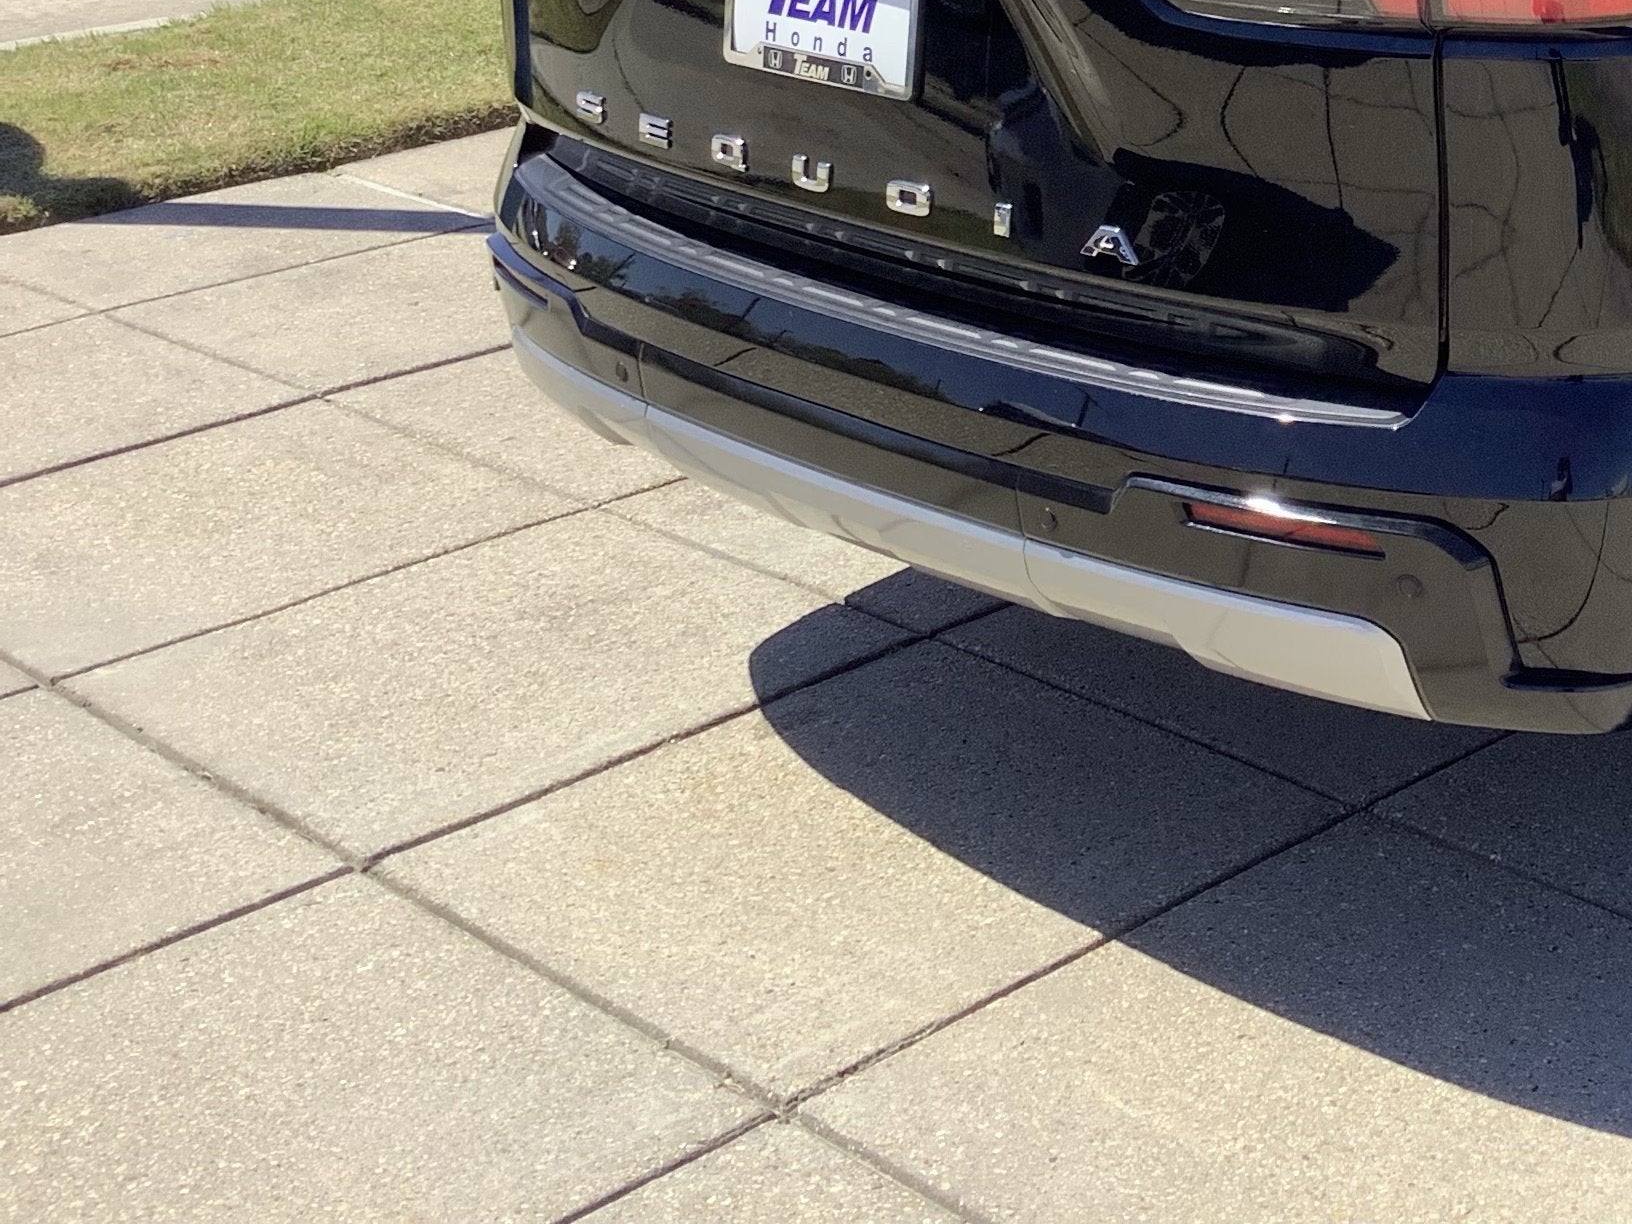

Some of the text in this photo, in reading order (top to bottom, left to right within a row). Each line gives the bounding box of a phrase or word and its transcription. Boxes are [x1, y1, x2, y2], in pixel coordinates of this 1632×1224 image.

[765, 20, 873, 63] Honda
[793, 54, 830, 81] TEAM
[575, 89, 1140, 267] SEQUOIA
